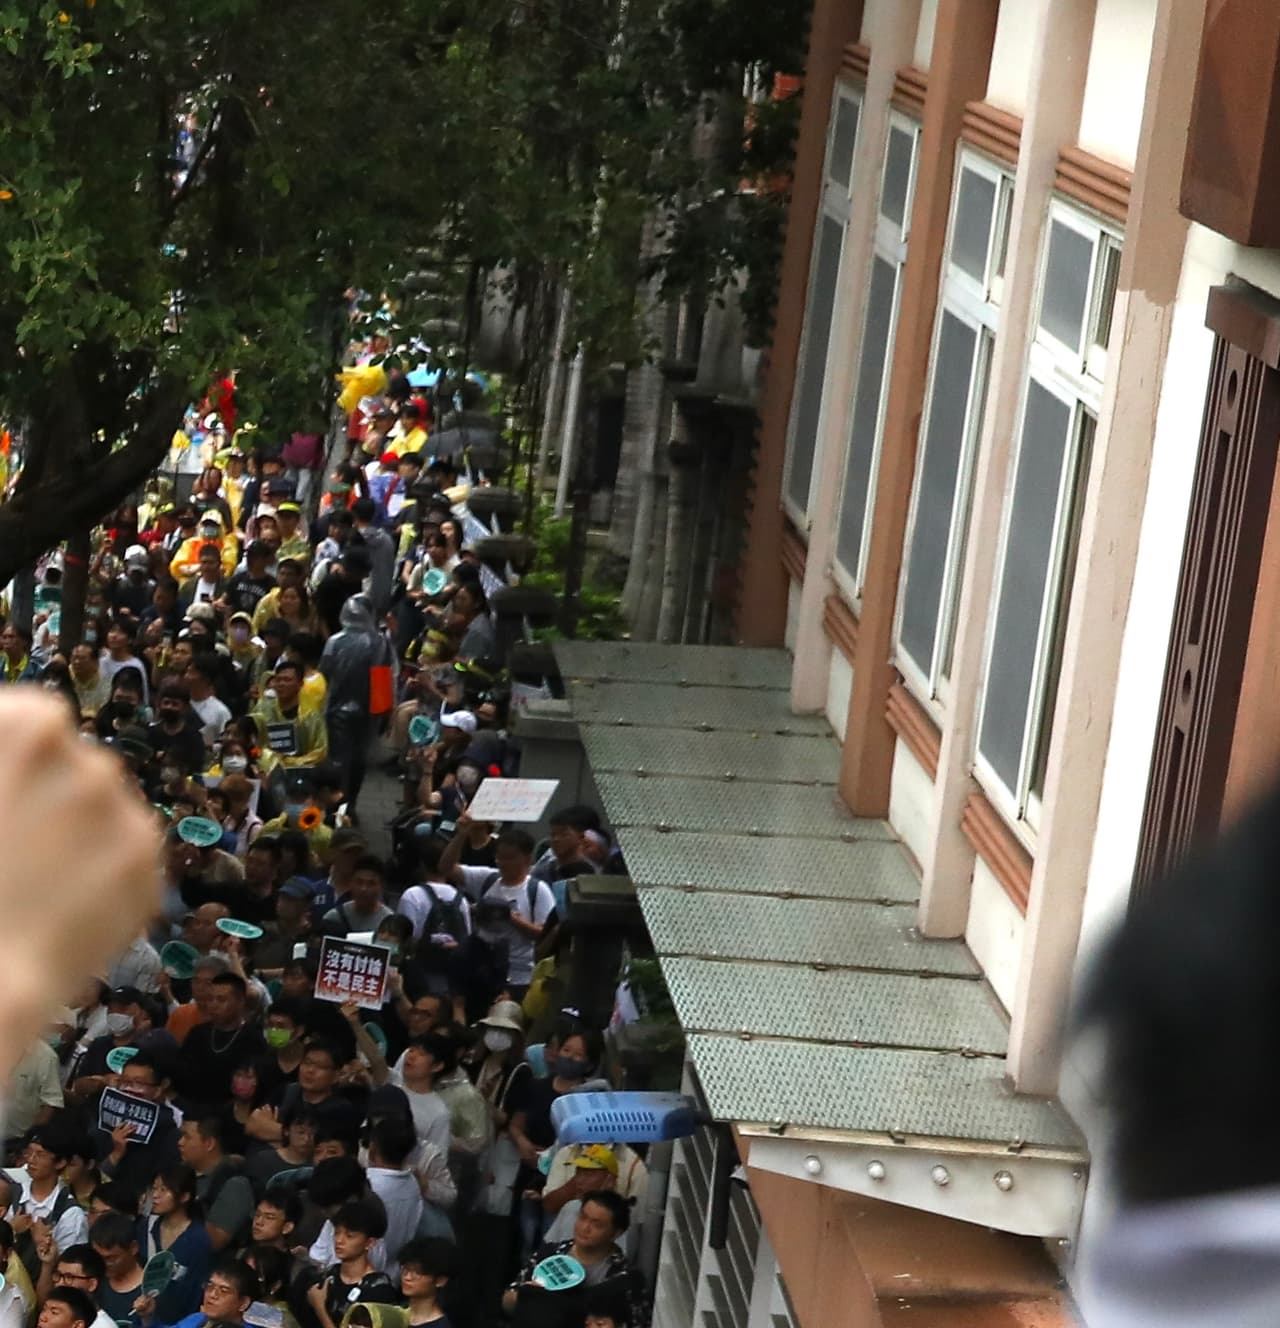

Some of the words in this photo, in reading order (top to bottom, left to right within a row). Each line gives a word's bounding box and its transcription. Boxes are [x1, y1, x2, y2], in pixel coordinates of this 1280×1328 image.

[326, 949, 383, 977] 沒有討論
[323, 970, 379, 996] 不是民主
